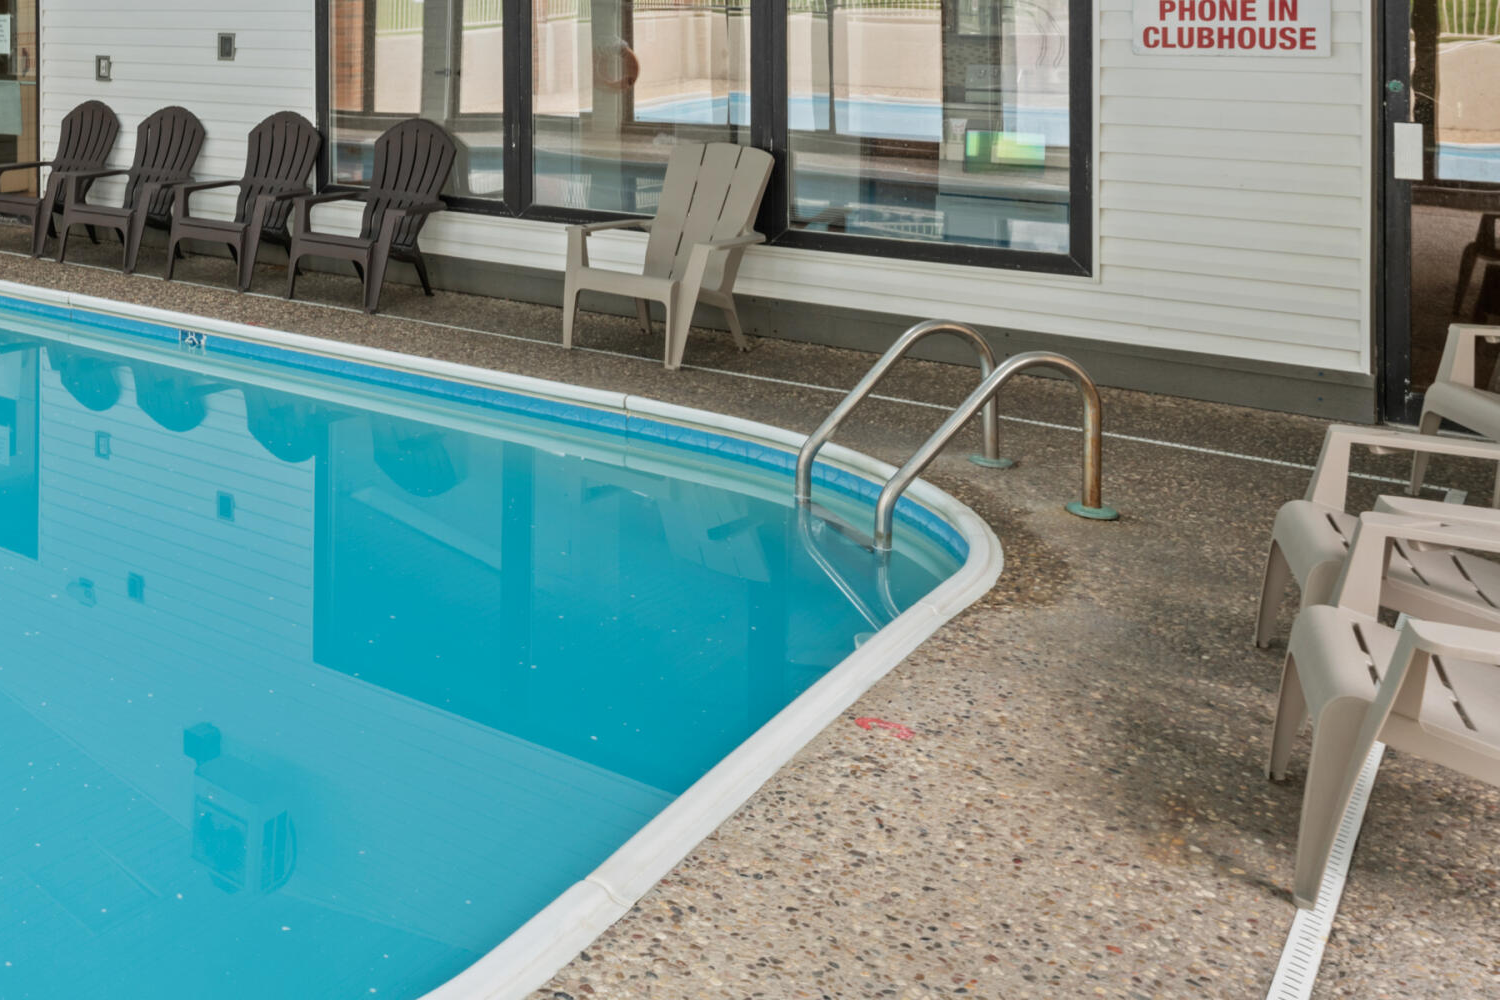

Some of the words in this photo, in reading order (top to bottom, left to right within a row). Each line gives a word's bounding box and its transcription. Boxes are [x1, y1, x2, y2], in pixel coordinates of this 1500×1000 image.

[1159, 0, 1257, 22] PHONE
[1268, 0, 1298, 21] IN
[1142, 26, 1316, 50] CLUBHOUSE
